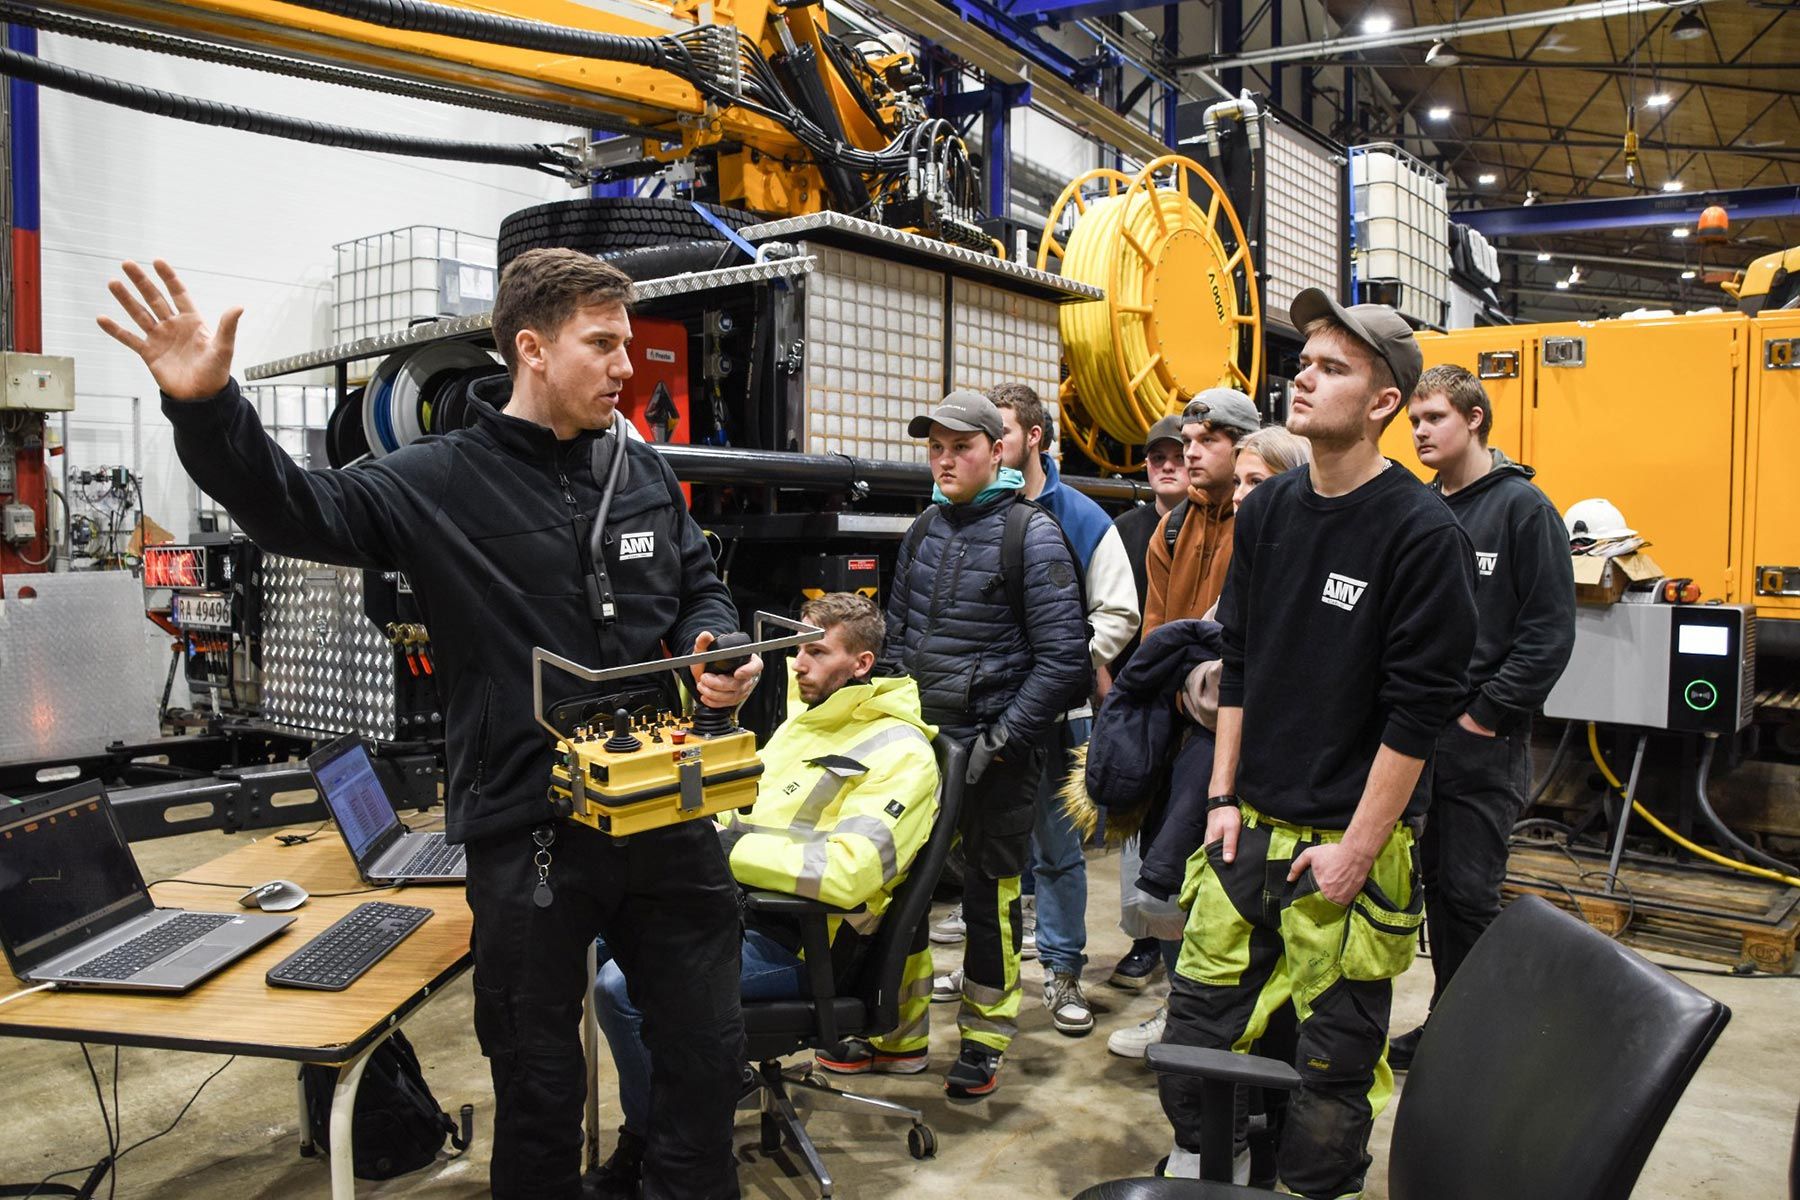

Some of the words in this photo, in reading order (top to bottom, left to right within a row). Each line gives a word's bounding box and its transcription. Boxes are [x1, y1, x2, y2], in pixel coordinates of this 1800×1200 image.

[1208, 273, 1216, 284] V
[1212, 285, 1225, 320] 1000
[620, 536, 654, 555] AMV
[1323, 578, 1365, 606] AMV
[180, 600, 192, 620] RA
[195, 601, 230, 623] 49496
